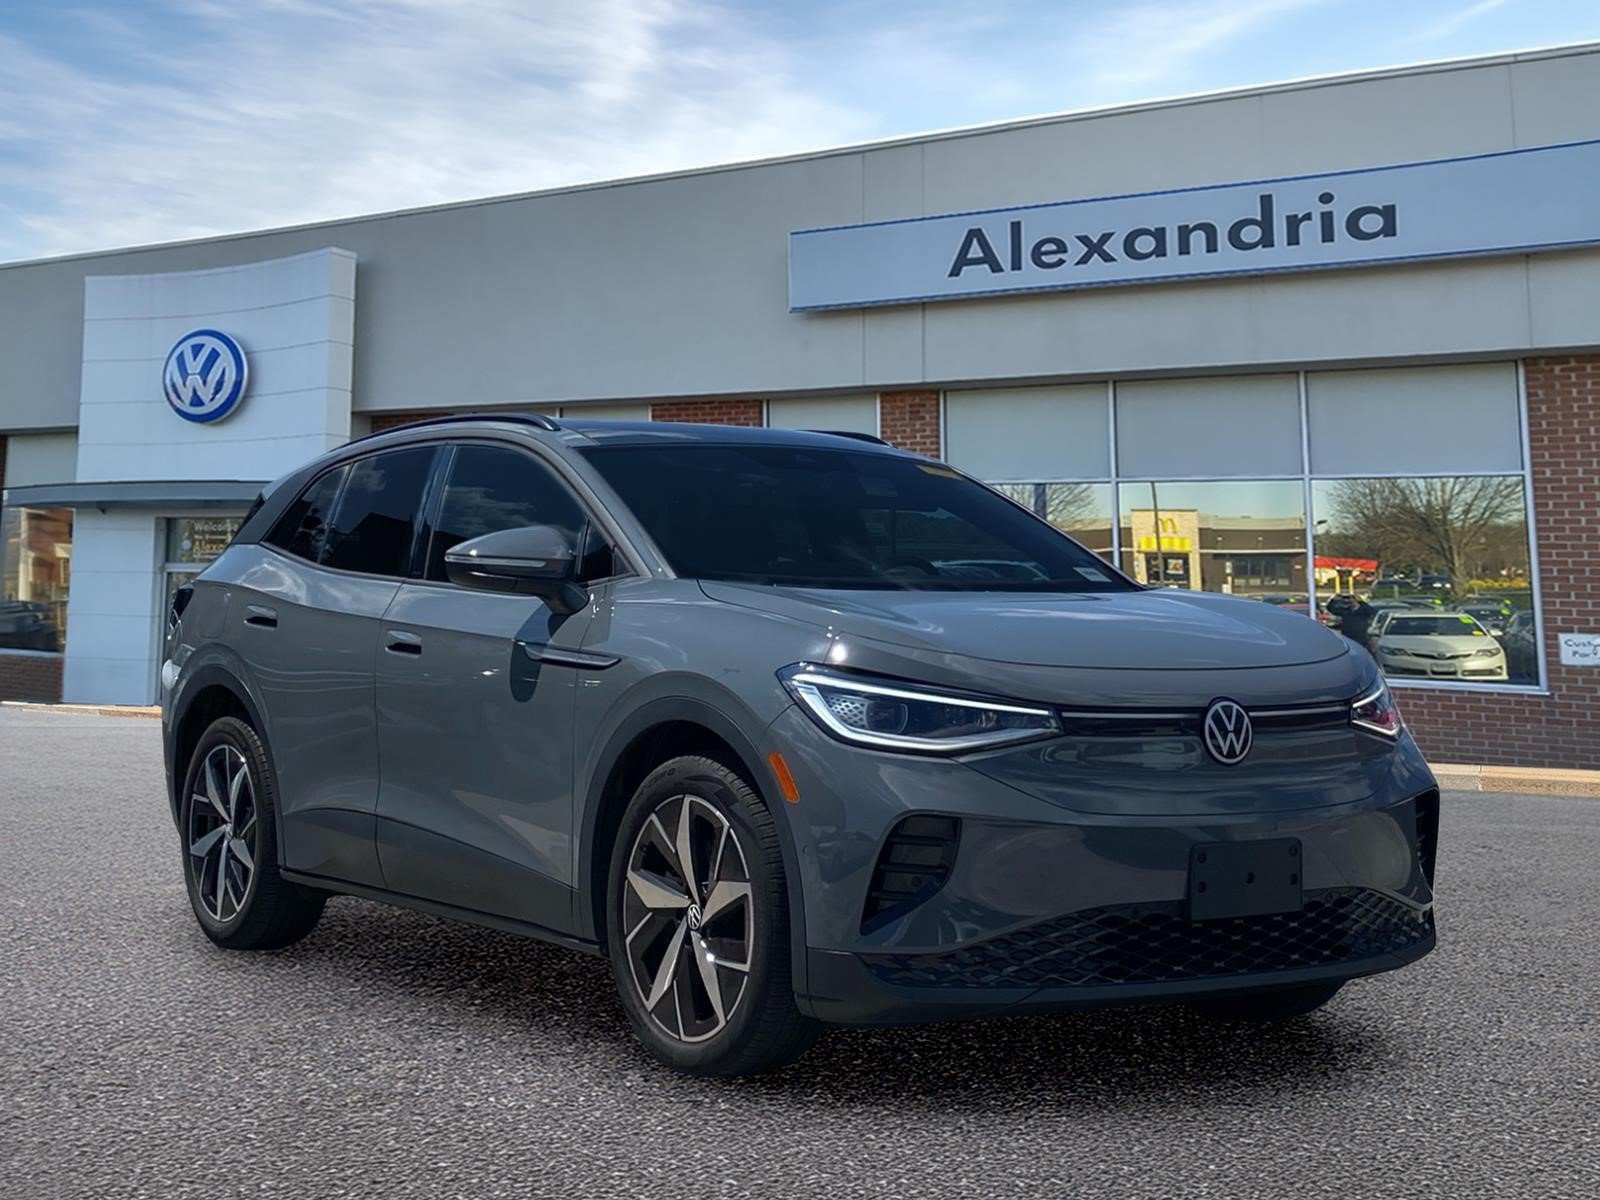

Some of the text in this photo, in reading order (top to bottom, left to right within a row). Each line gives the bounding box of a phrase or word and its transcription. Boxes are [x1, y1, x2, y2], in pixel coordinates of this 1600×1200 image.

[948, 192, 1397, 278] Alexandria
[167, 338, 234, 412] VW
[1206, 703, 1250, 761] VW
